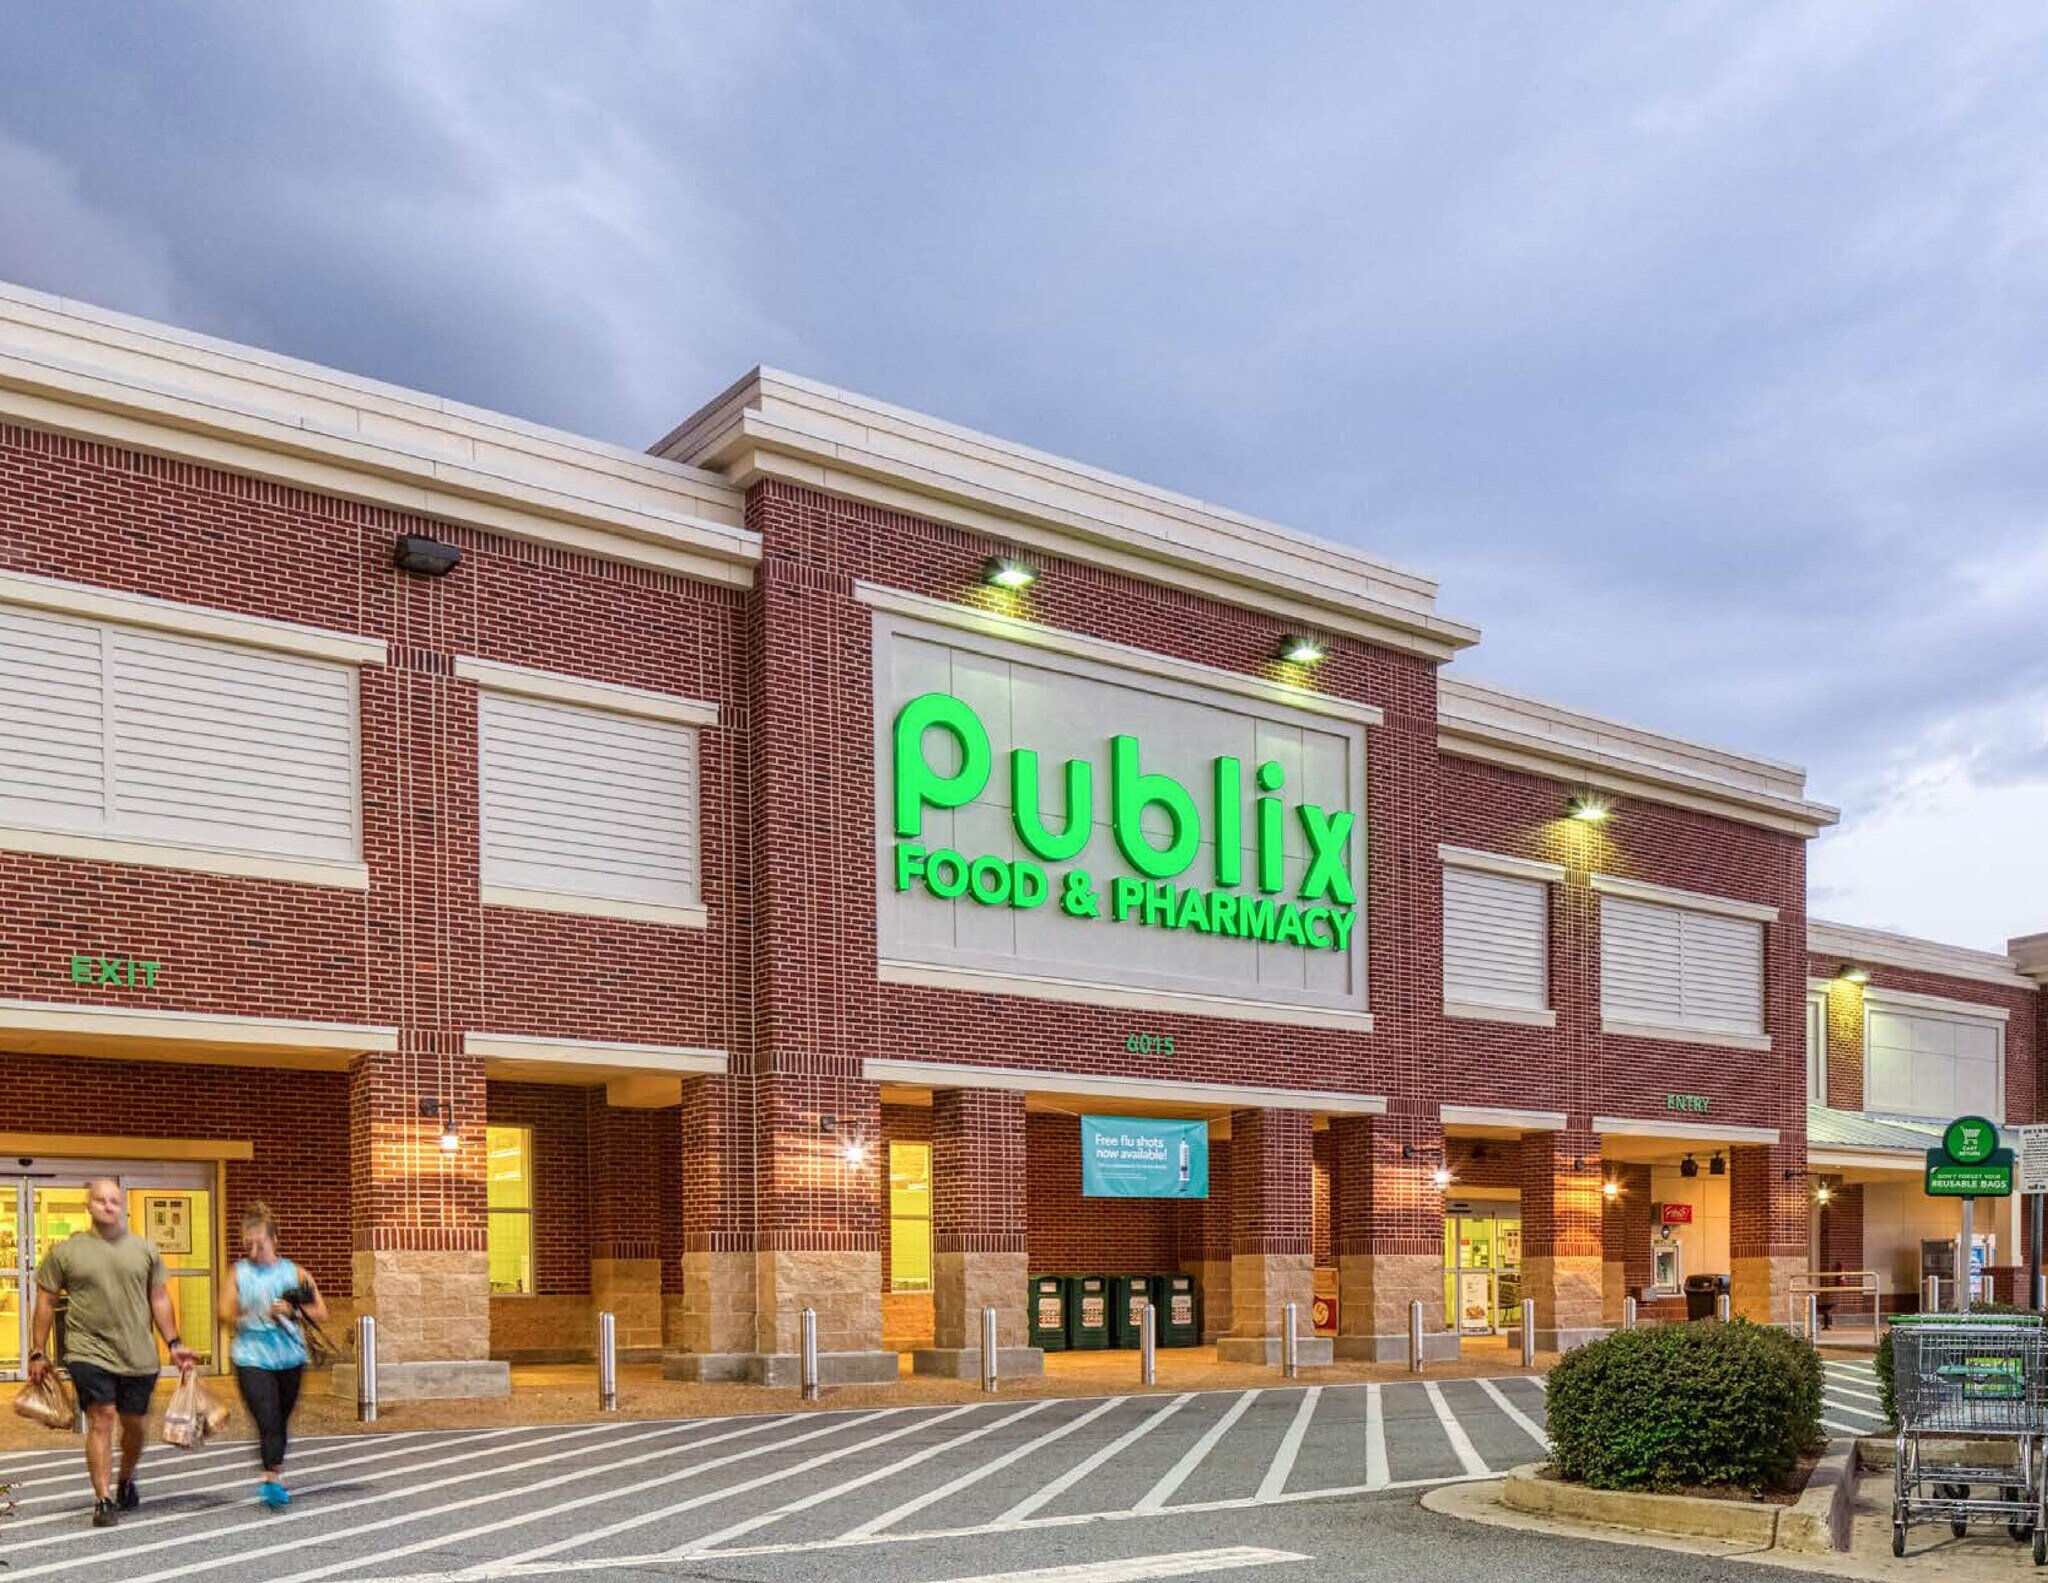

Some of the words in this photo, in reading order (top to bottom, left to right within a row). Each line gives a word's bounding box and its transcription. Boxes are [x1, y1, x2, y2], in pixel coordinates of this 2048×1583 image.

[893, 692, 1357, 905] Publix
[895, 843, 1049, 909] FOOD
[1060, 868, 1100, 918] &
[1111, 876, 1357, 952] PHARMACY
[72, 955, 161, 988] EXIT
[1126, 1032, 1175, 1056] 6015
[1667, 1093, 1709, 1112] ENTRY
[1095, 1133, 1118, 1147] Free
[1121, 1134, 1134, 1147] flu
[1136, 1136, 1164, 1149] shots
[1096, 1147, 1120, 1159] now
[1120, 1147, 1168, 1160] available!
[1931, 1180, 1978, 1188] REUSABLE
[1980, 1180, 2007, 1189] BAGS
